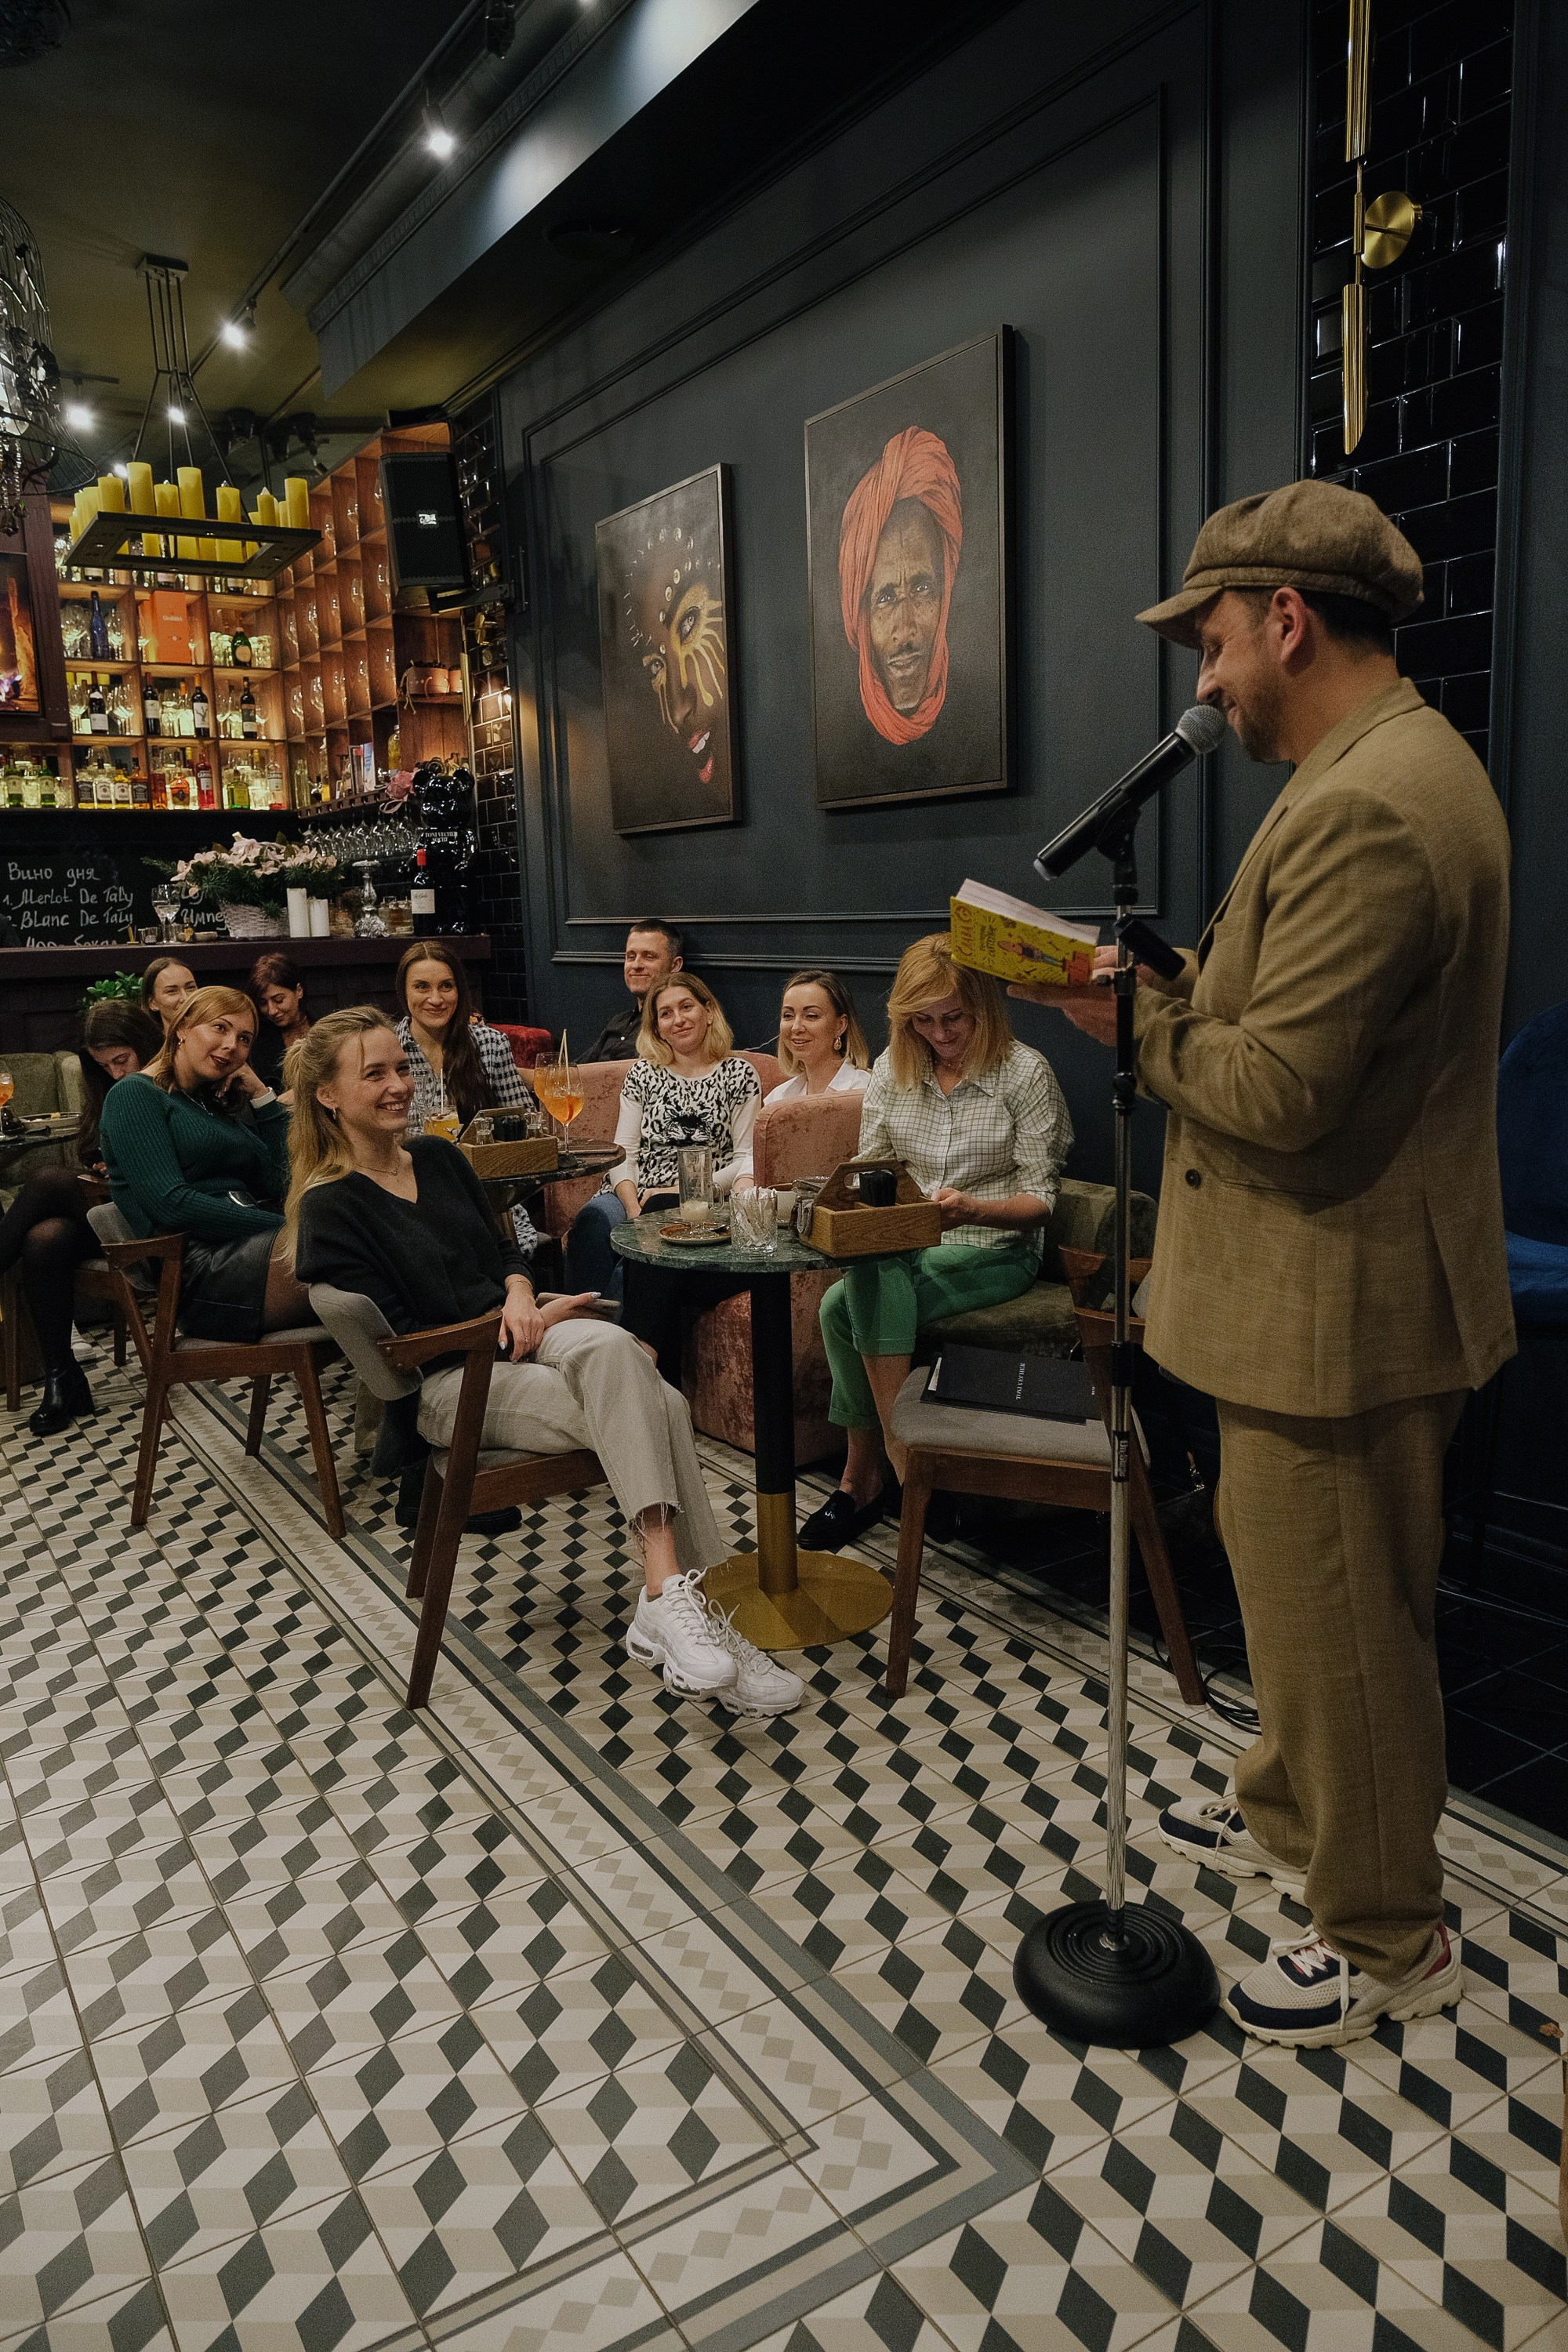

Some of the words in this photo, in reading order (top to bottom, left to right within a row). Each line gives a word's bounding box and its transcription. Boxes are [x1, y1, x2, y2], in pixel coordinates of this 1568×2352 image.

[8, 862, 53, 880] Вино
[67, 868, 100, 887] дня
[80, 888, 98, 904] De
[80, 909, 99, 927] De
